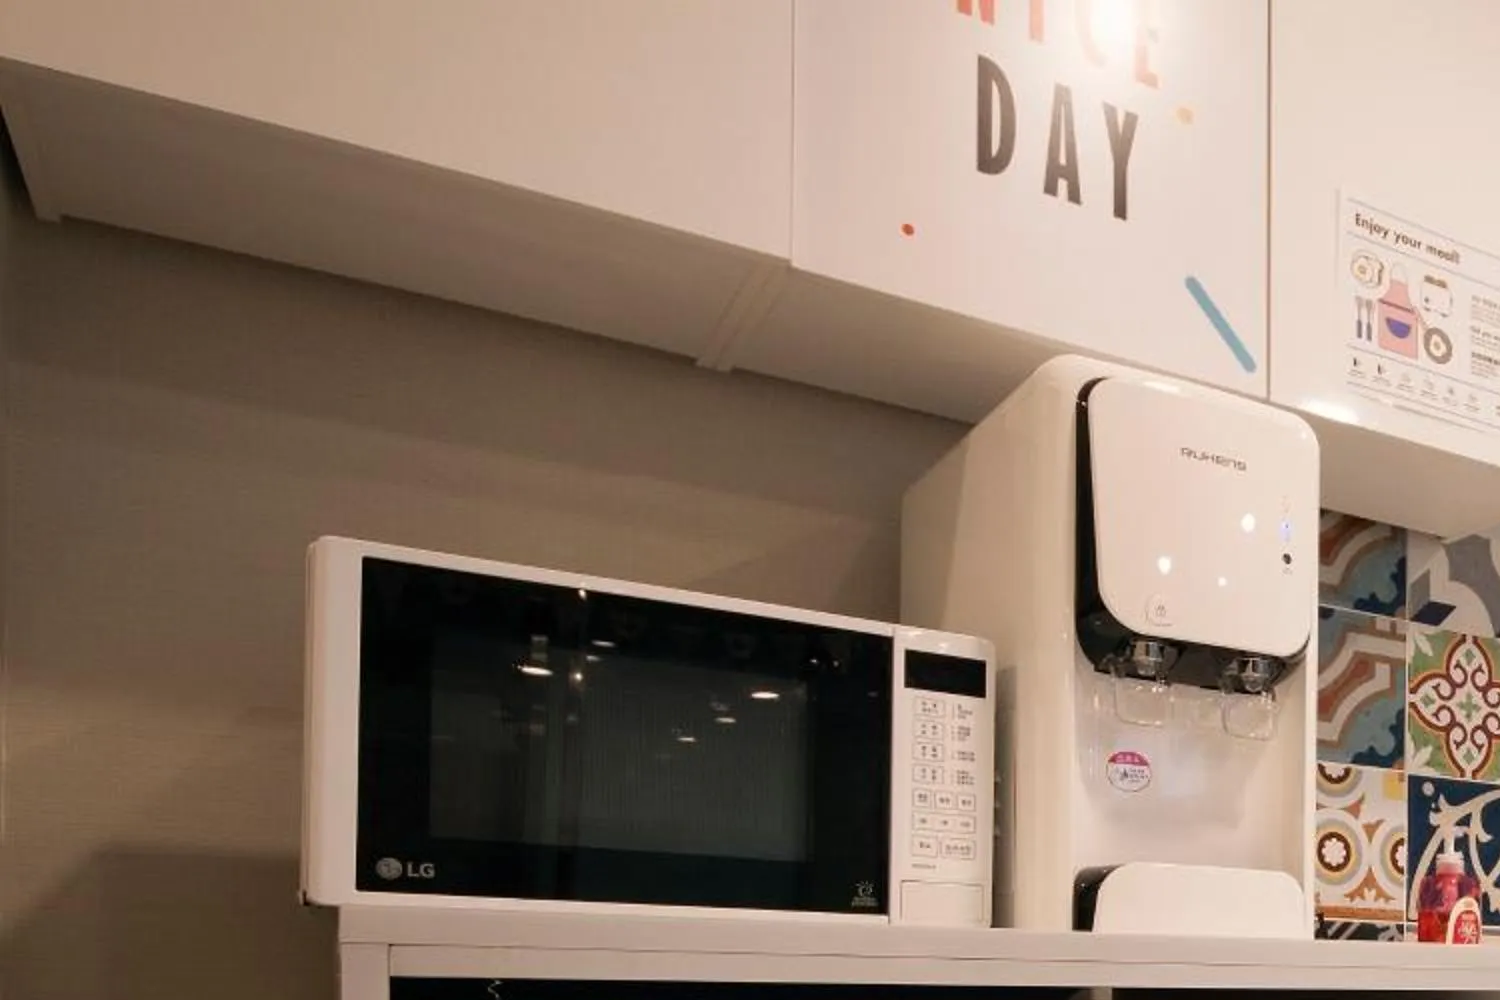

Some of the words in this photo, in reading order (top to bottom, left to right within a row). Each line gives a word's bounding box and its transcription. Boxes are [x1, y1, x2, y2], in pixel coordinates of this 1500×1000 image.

[977, 54, 1138, 221] DAY
[1355, 213, 1389, 238] Enjoy
[1394, 231, 1422, 250] your
[407, 862, 435, 878] LG
